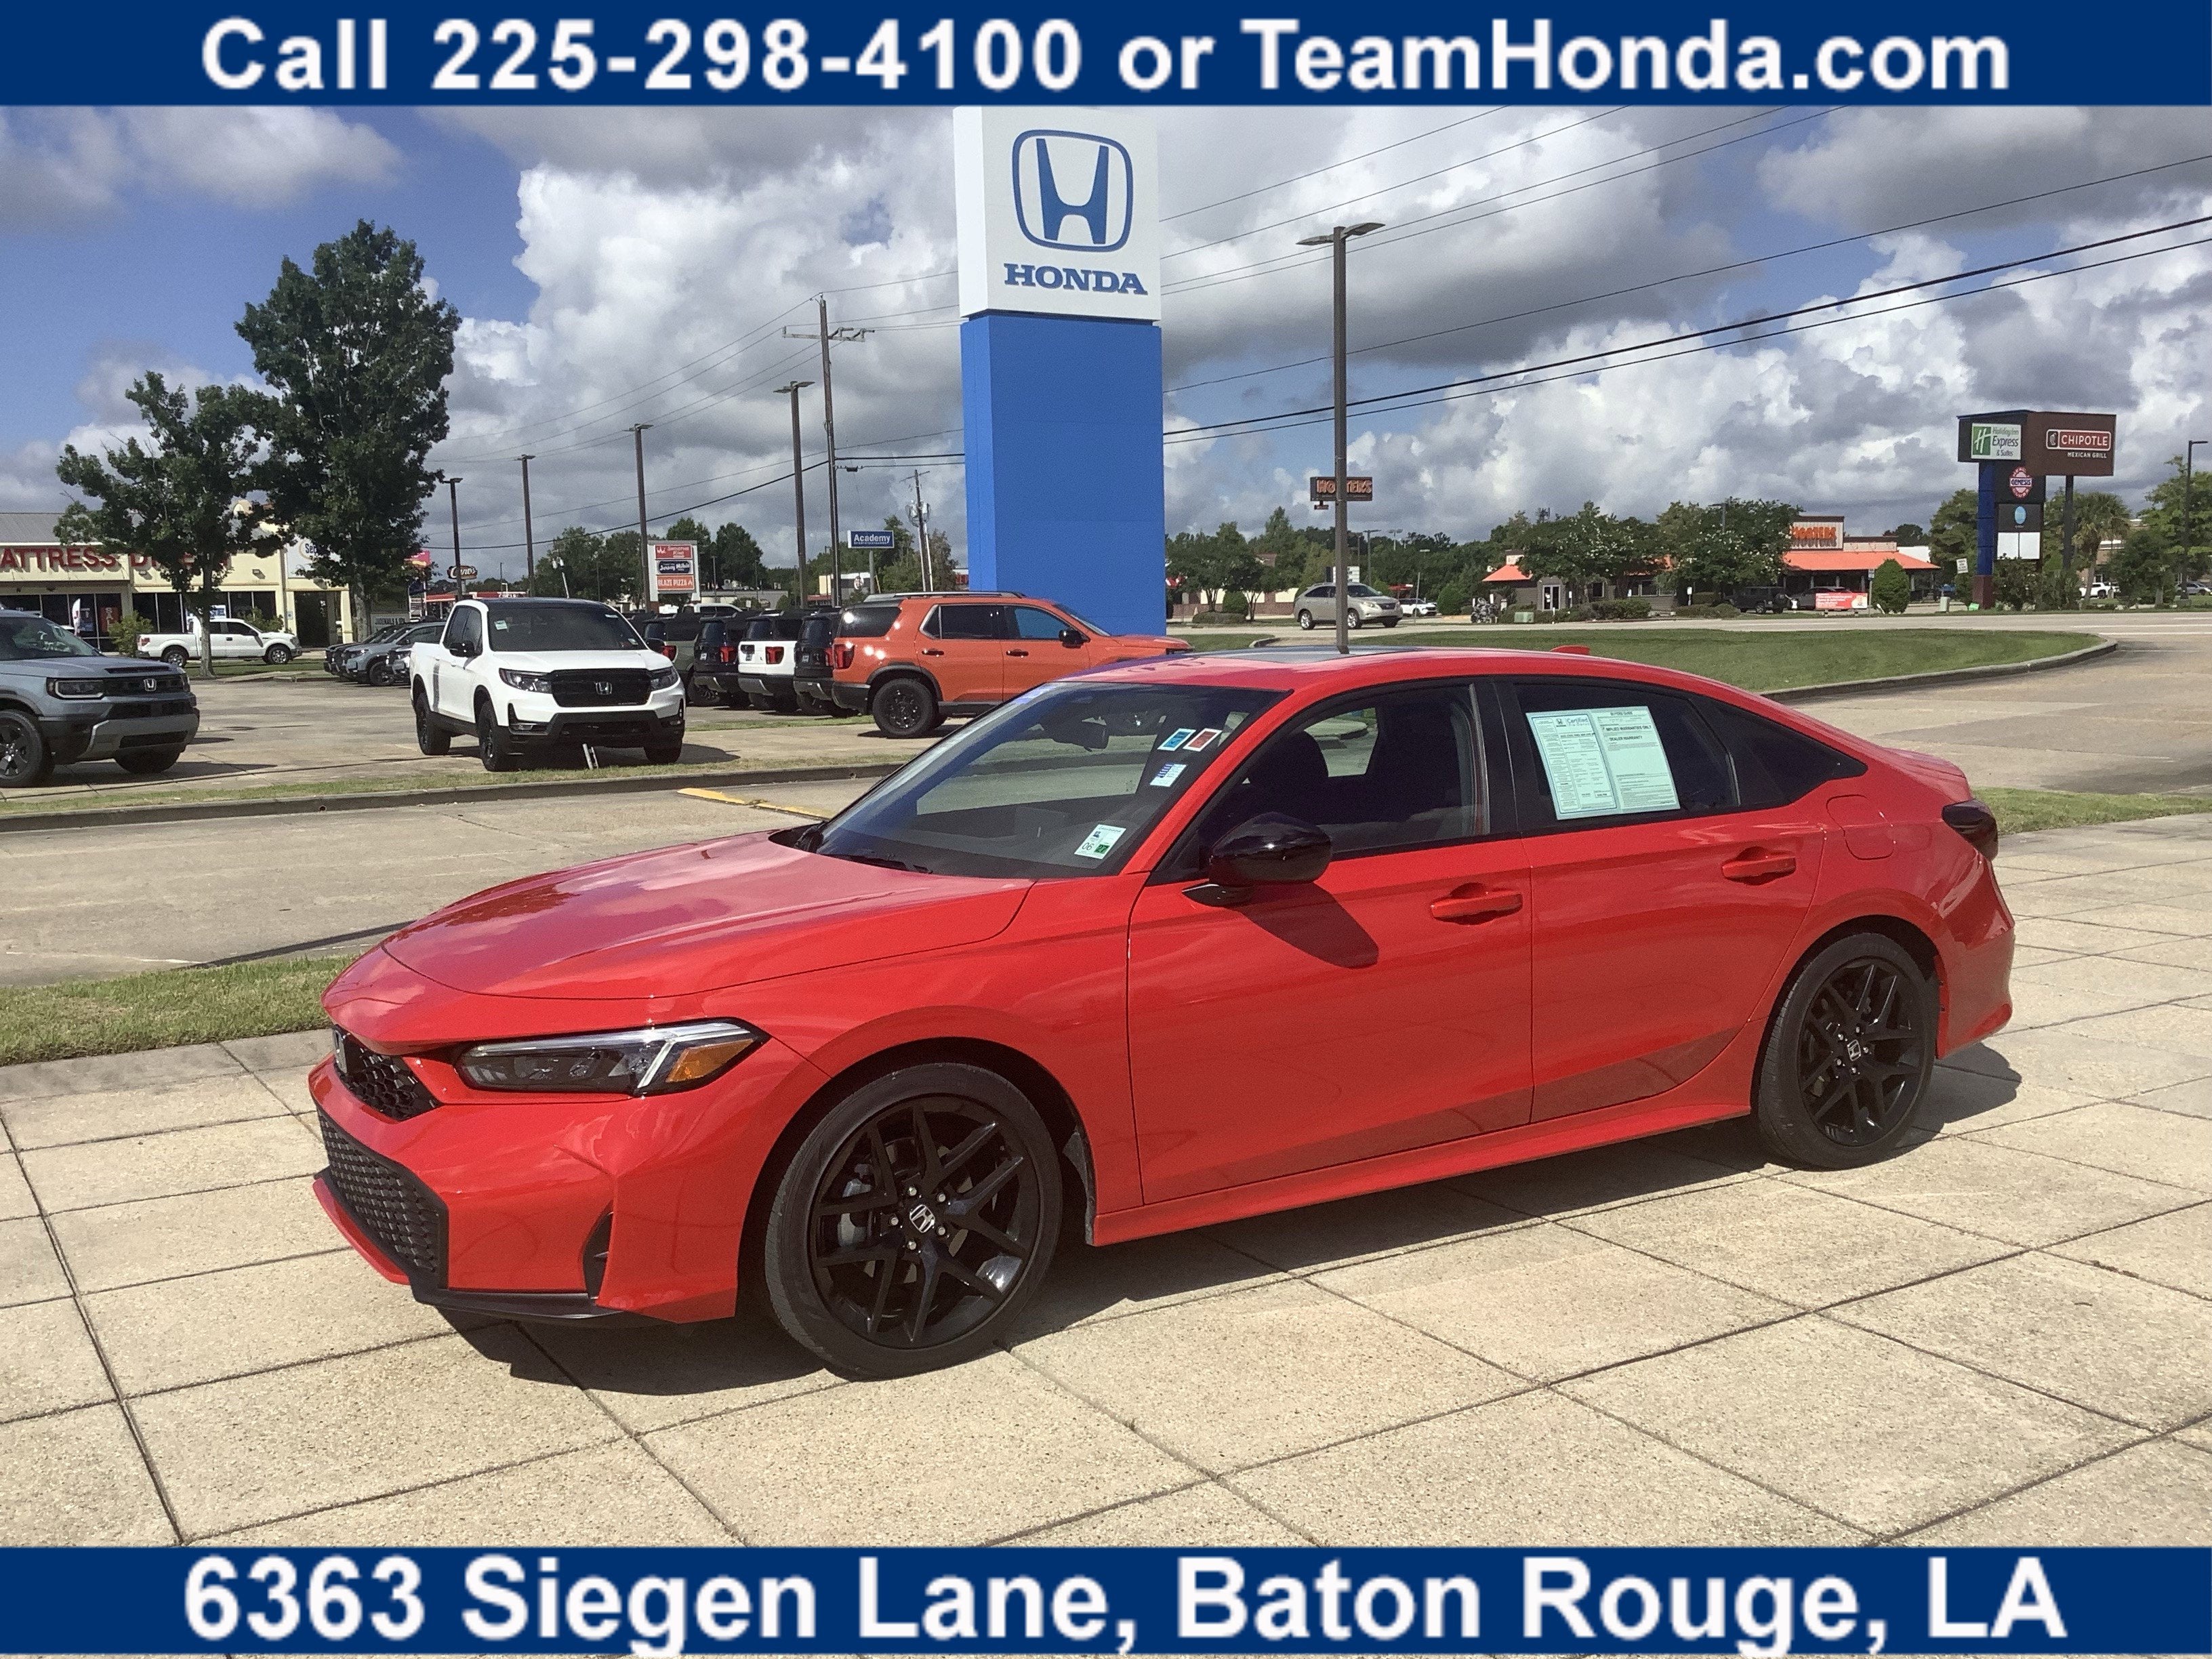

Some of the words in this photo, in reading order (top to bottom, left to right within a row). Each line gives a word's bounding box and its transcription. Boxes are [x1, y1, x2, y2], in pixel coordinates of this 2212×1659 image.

[1004, 263, 1148, 295] HONDA
[1992, 435, 2019, 449] Express
[2061, 434, 2108, 447] CHIPOTLE
[1316, 479, 1372, 493] HOTERS
[854, 534, 890, 544] Academy
[1082, 842, 1095, 851] 06
